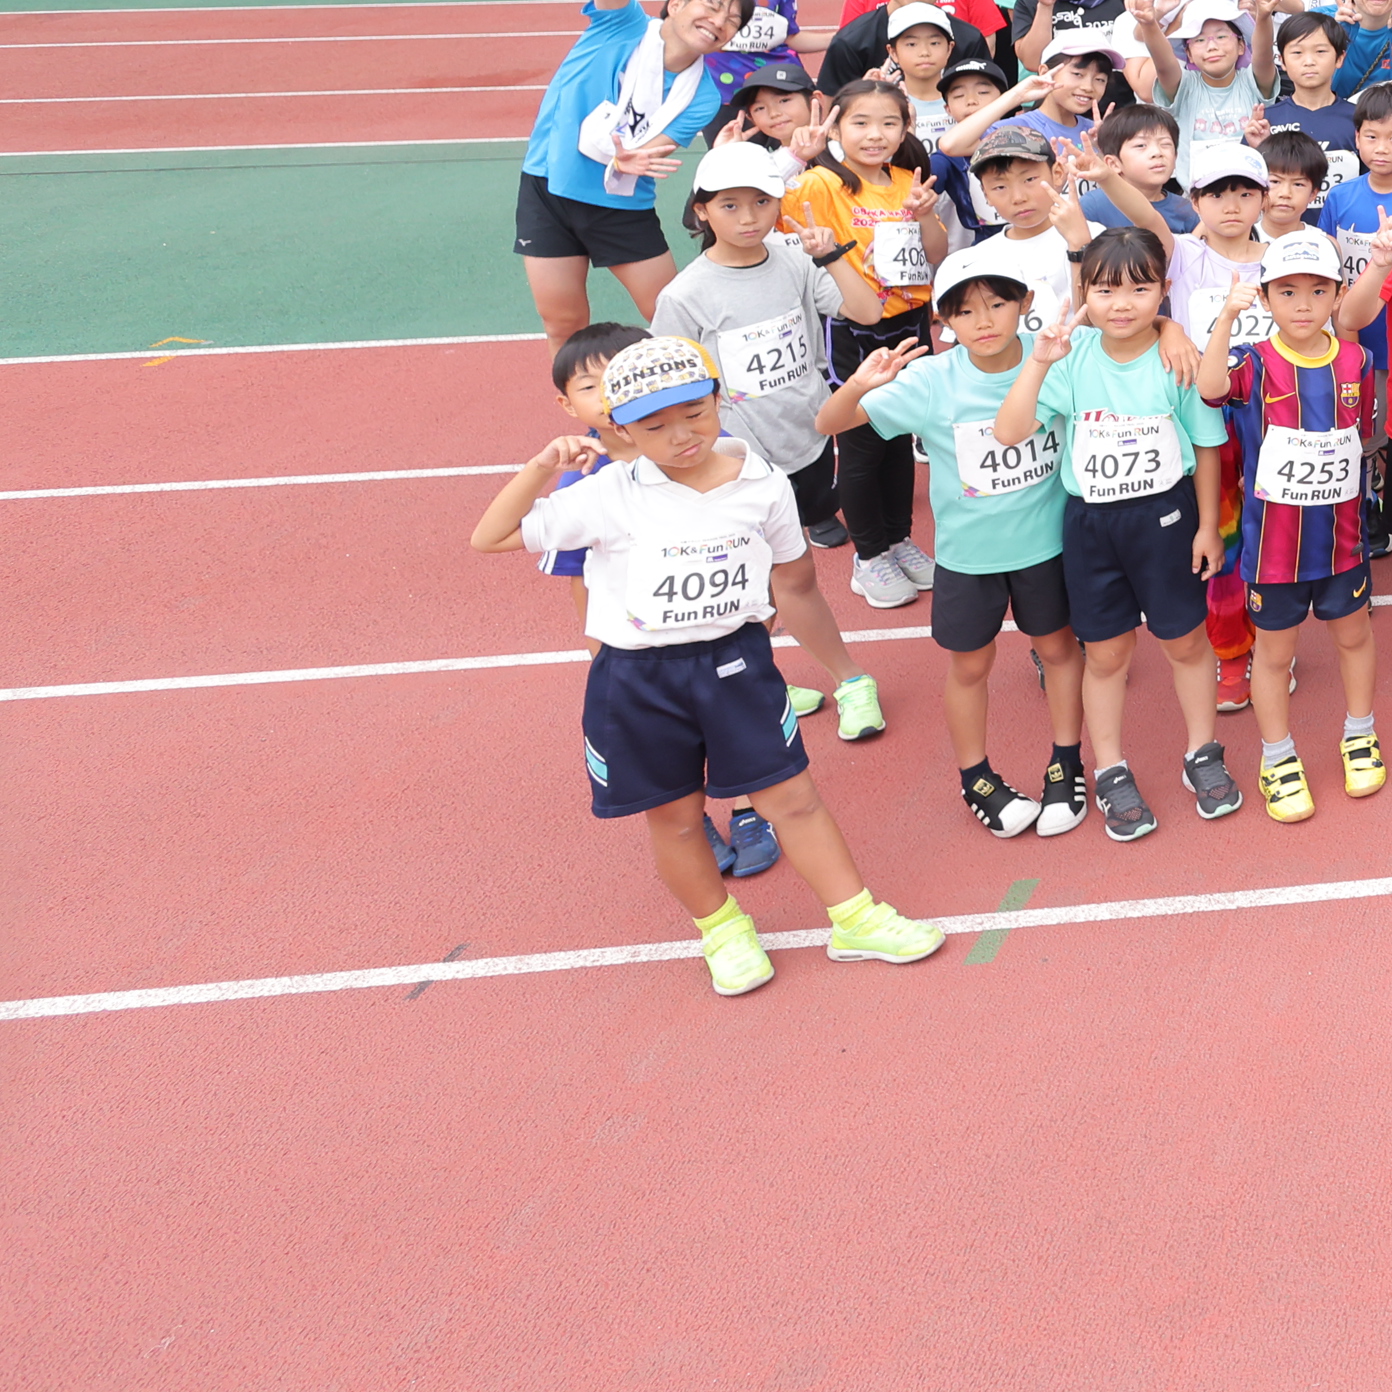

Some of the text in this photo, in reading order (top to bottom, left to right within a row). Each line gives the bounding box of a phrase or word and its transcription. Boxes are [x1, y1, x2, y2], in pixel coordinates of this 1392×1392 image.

[739, 25, 775, 40] 034
[749, 41, 768, 50] RUN
[1269, 122, 1301, 134] GAVIC
[745, 335, 808, 376] 4215
[609, 356, 698, 394] MINIONS
[758, 361, 808, 391] Fun RUN
[978, 428, 1061, 475] 4014
[1083, 448, 1162, 480] 4073
[991, 460, 1055, 490] Fun RUN
[1276, 457, 1350, 486] 4253
[1089, 478, 1155, 498] Fun RUN
[1281, 487, 1342, 501] Fun RUN
[651, 562, 750, 604] 4094
[661, 598, 741, 624] Fun RUN
